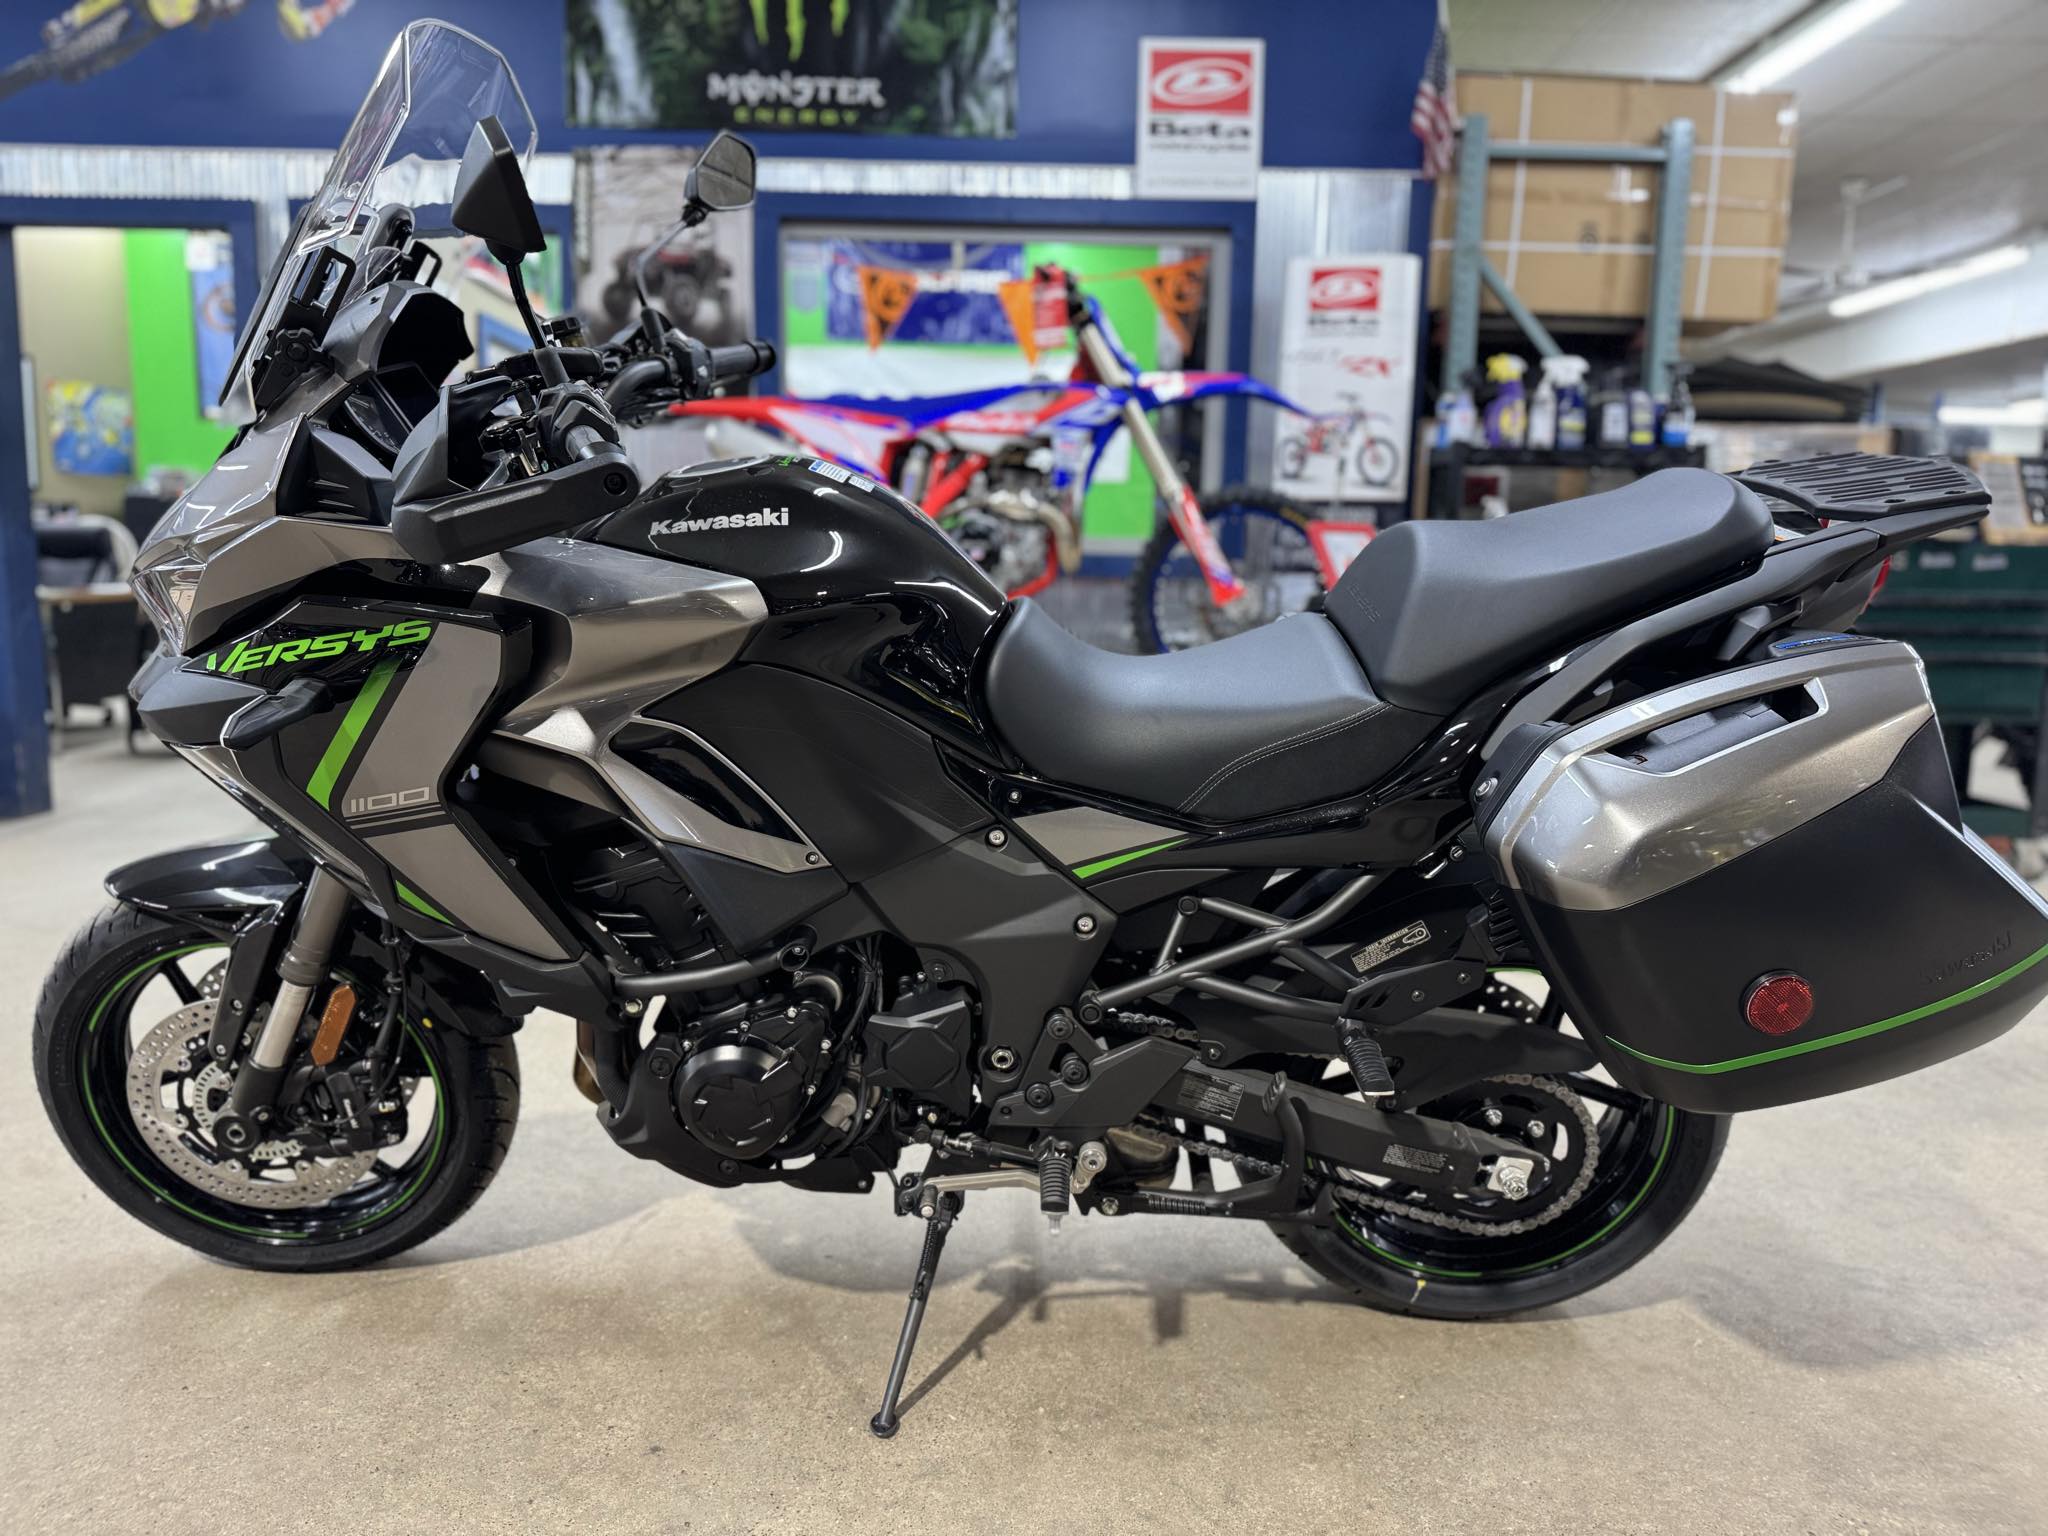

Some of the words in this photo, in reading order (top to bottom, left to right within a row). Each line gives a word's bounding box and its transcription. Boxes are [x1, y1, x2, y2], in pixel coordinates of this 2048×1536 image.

[707, 70, 886, 108] MONSTER
[733, 106, 859, 126] ENERGY
[1150, 119, 1251, 138] Beta
[650, 507, 789, 536] Kawasaki
[206, 620, 432, 674] VERSYS
[350, 786, 430, 813] 1100
